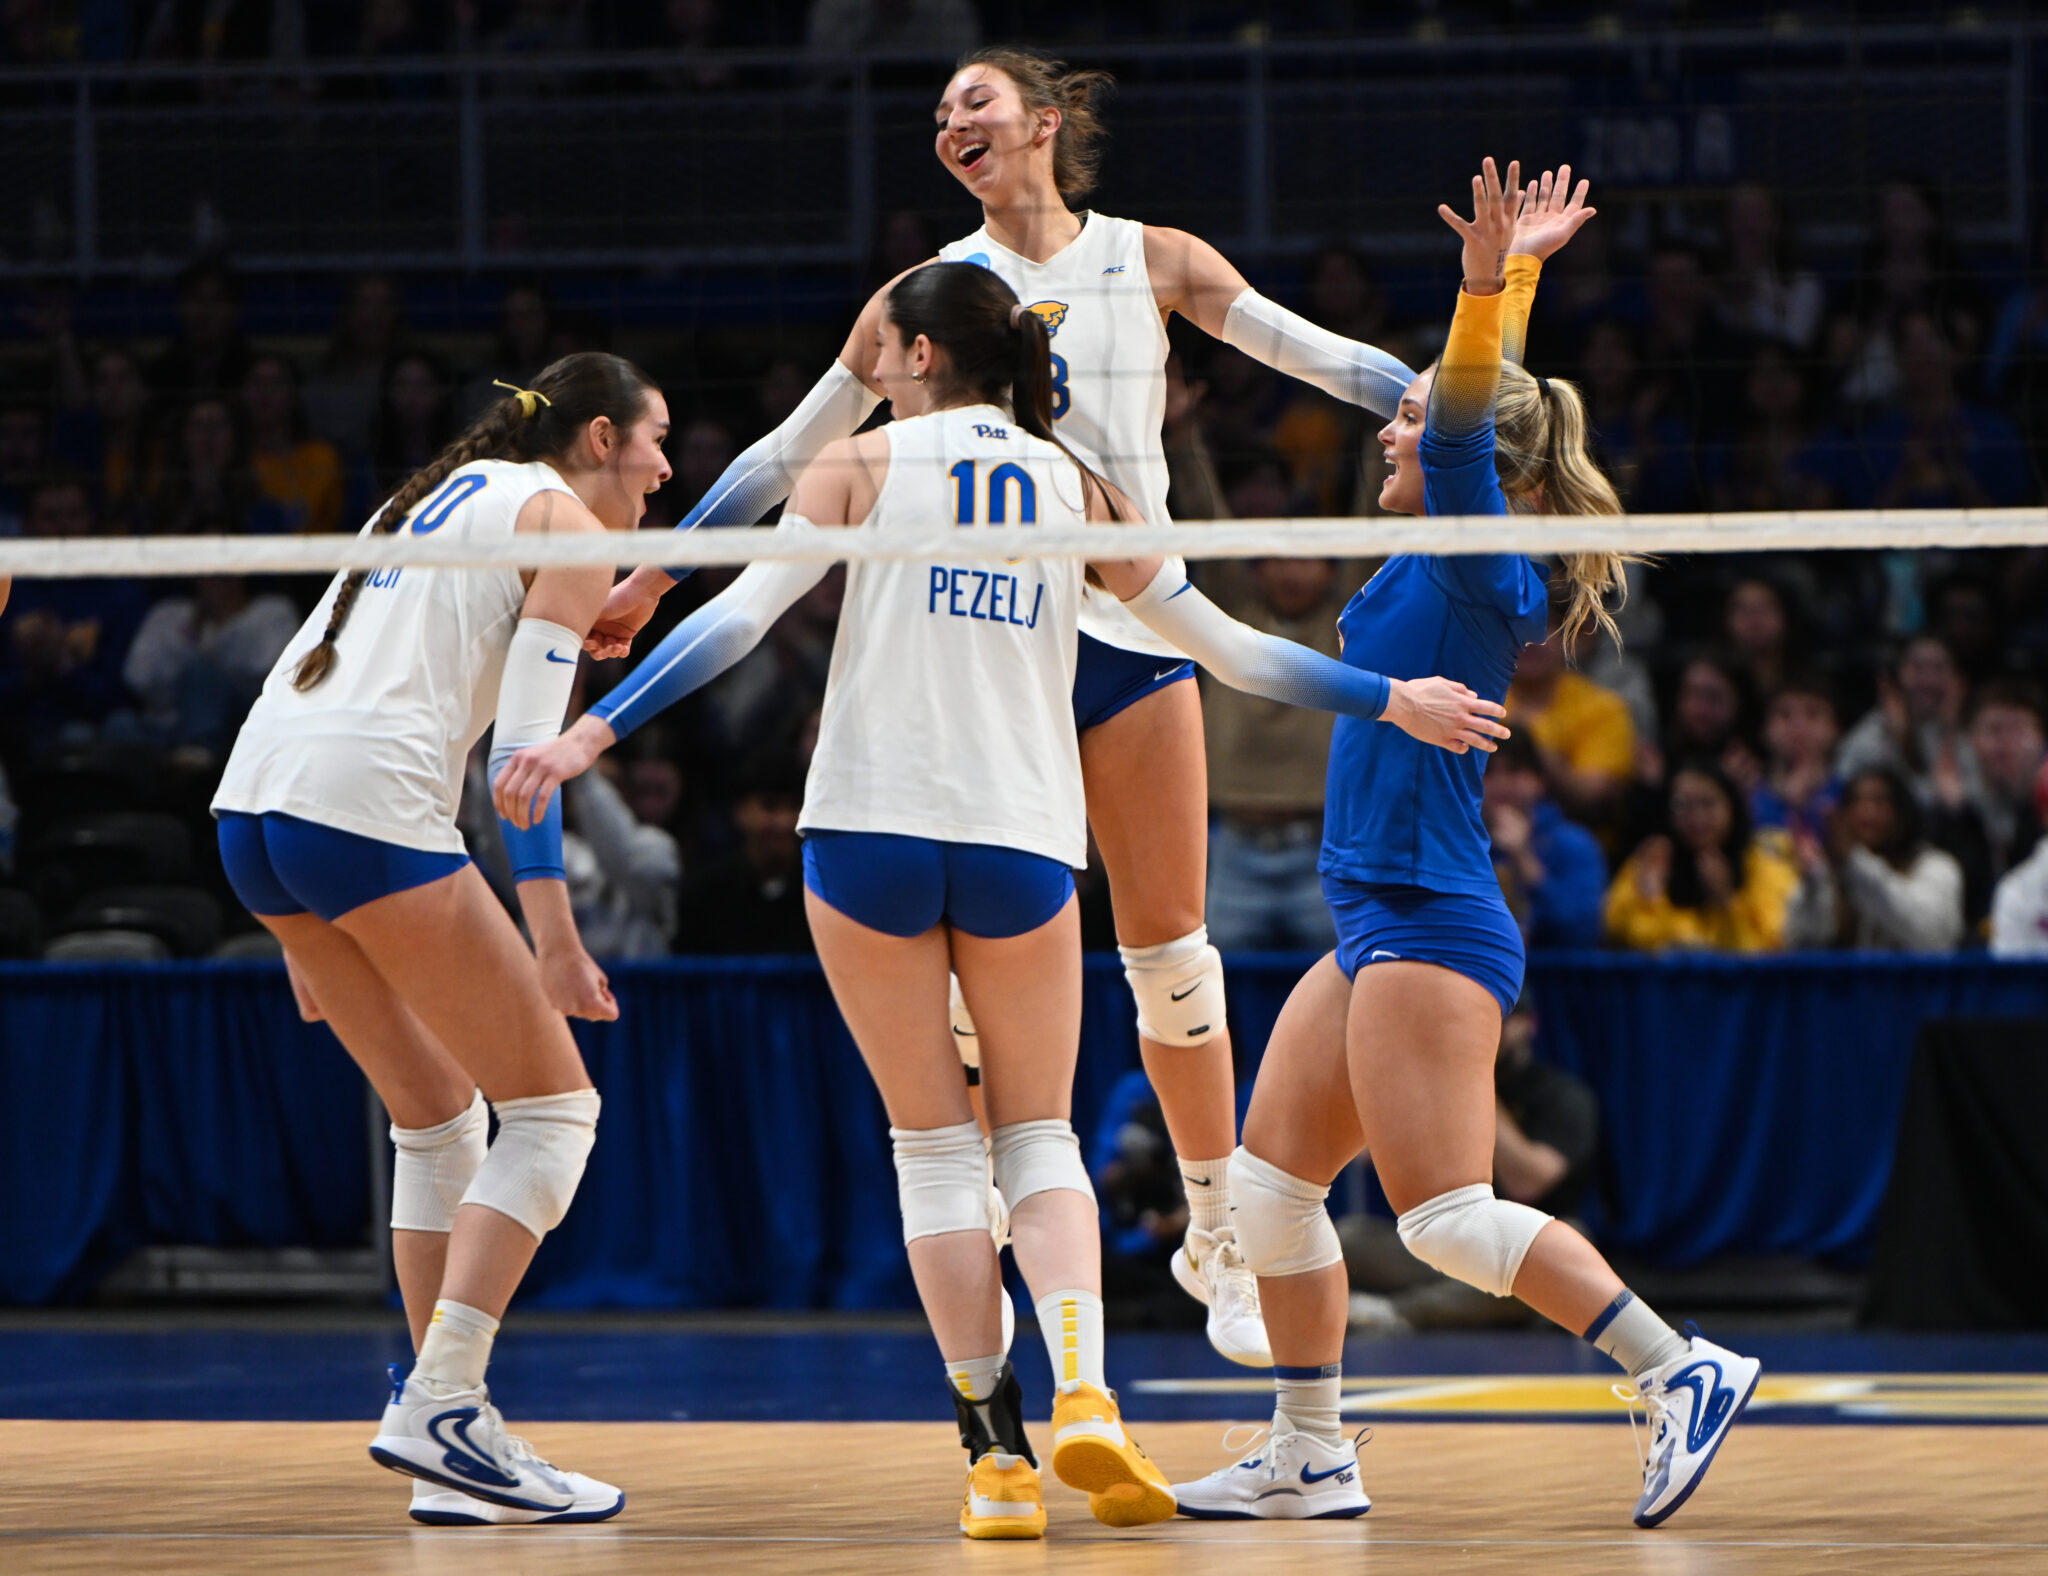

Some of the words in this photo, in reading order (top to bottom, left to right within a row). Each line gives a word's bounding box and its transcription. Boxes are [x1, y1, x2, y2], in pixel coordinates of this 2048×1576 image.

[1102, 265, 1126, 274] ACC
[971, 424, 1008, 440] Pitt
[948, 458, 1039, 564] 10
[929, 566, 1044, 629] PEZELJ
